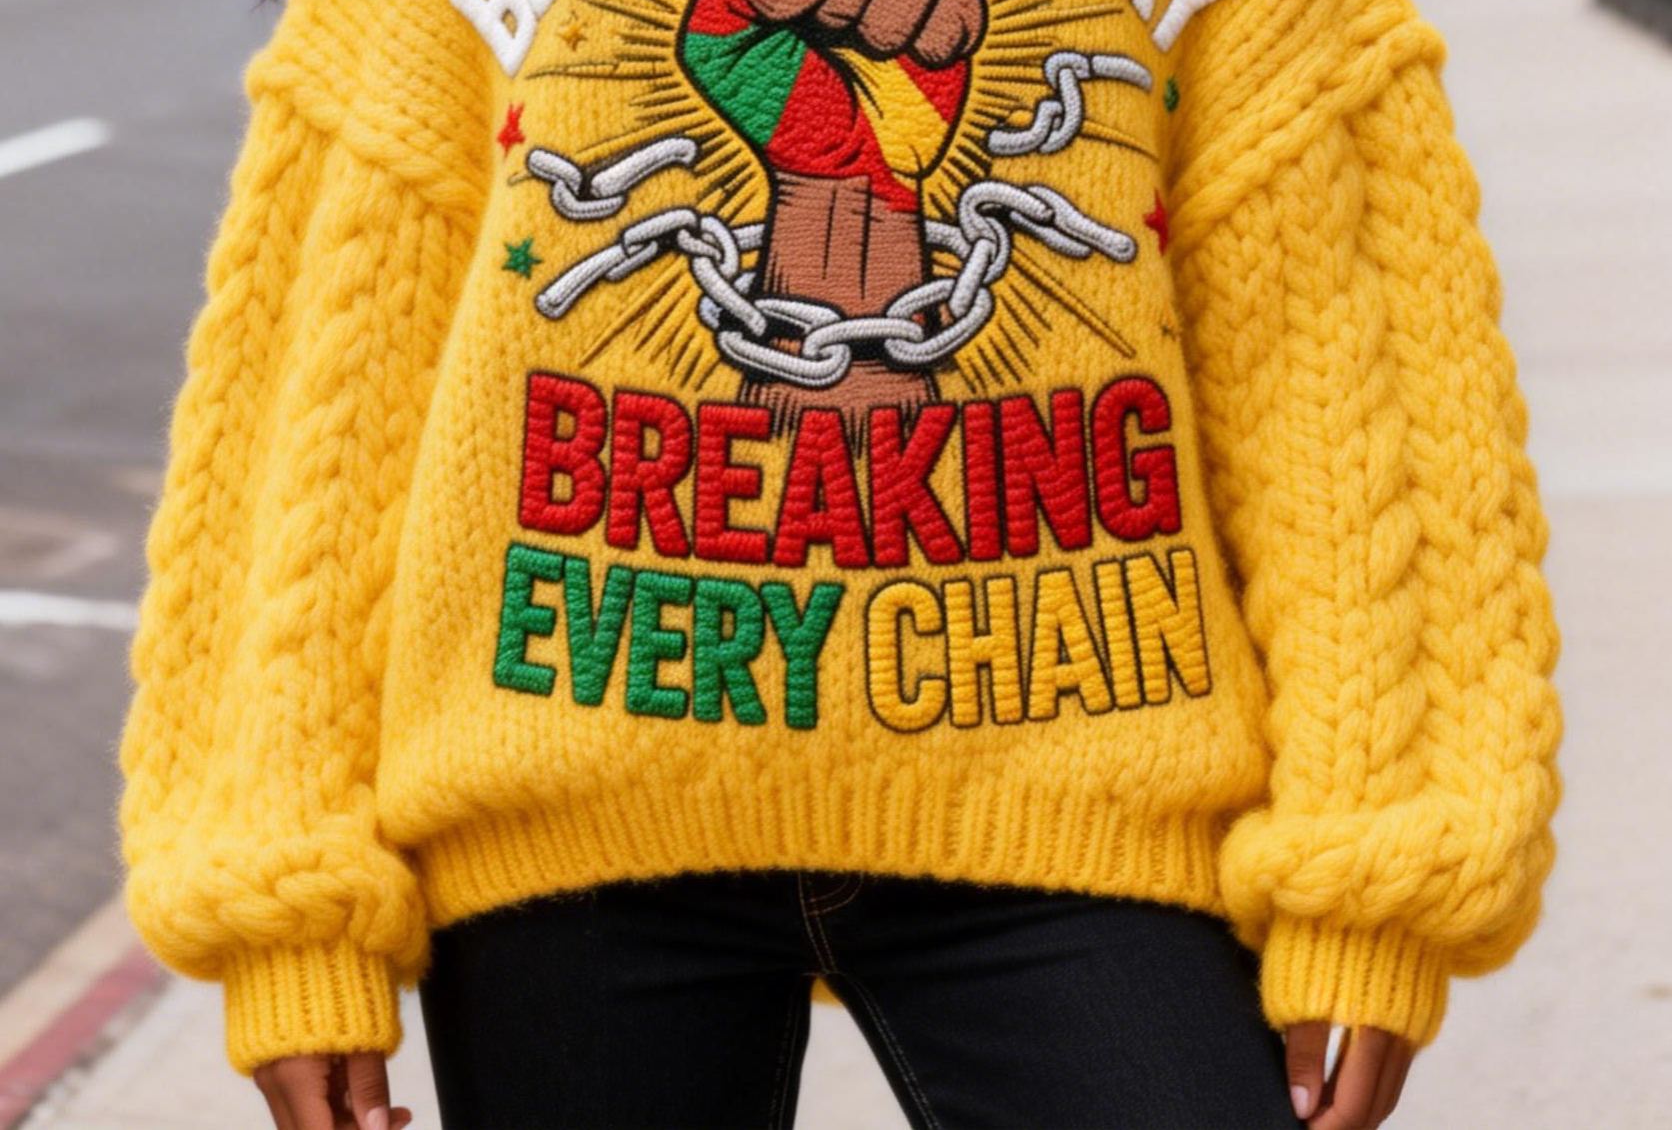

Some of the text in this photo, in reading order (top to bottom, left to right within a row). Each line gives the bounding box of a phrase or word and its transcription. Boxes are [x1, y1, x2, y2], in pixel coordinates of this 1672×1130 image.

[517, 371, 1183, 569] BREAKING
[493, 541, 1212, 734] EVERY CHAIN
